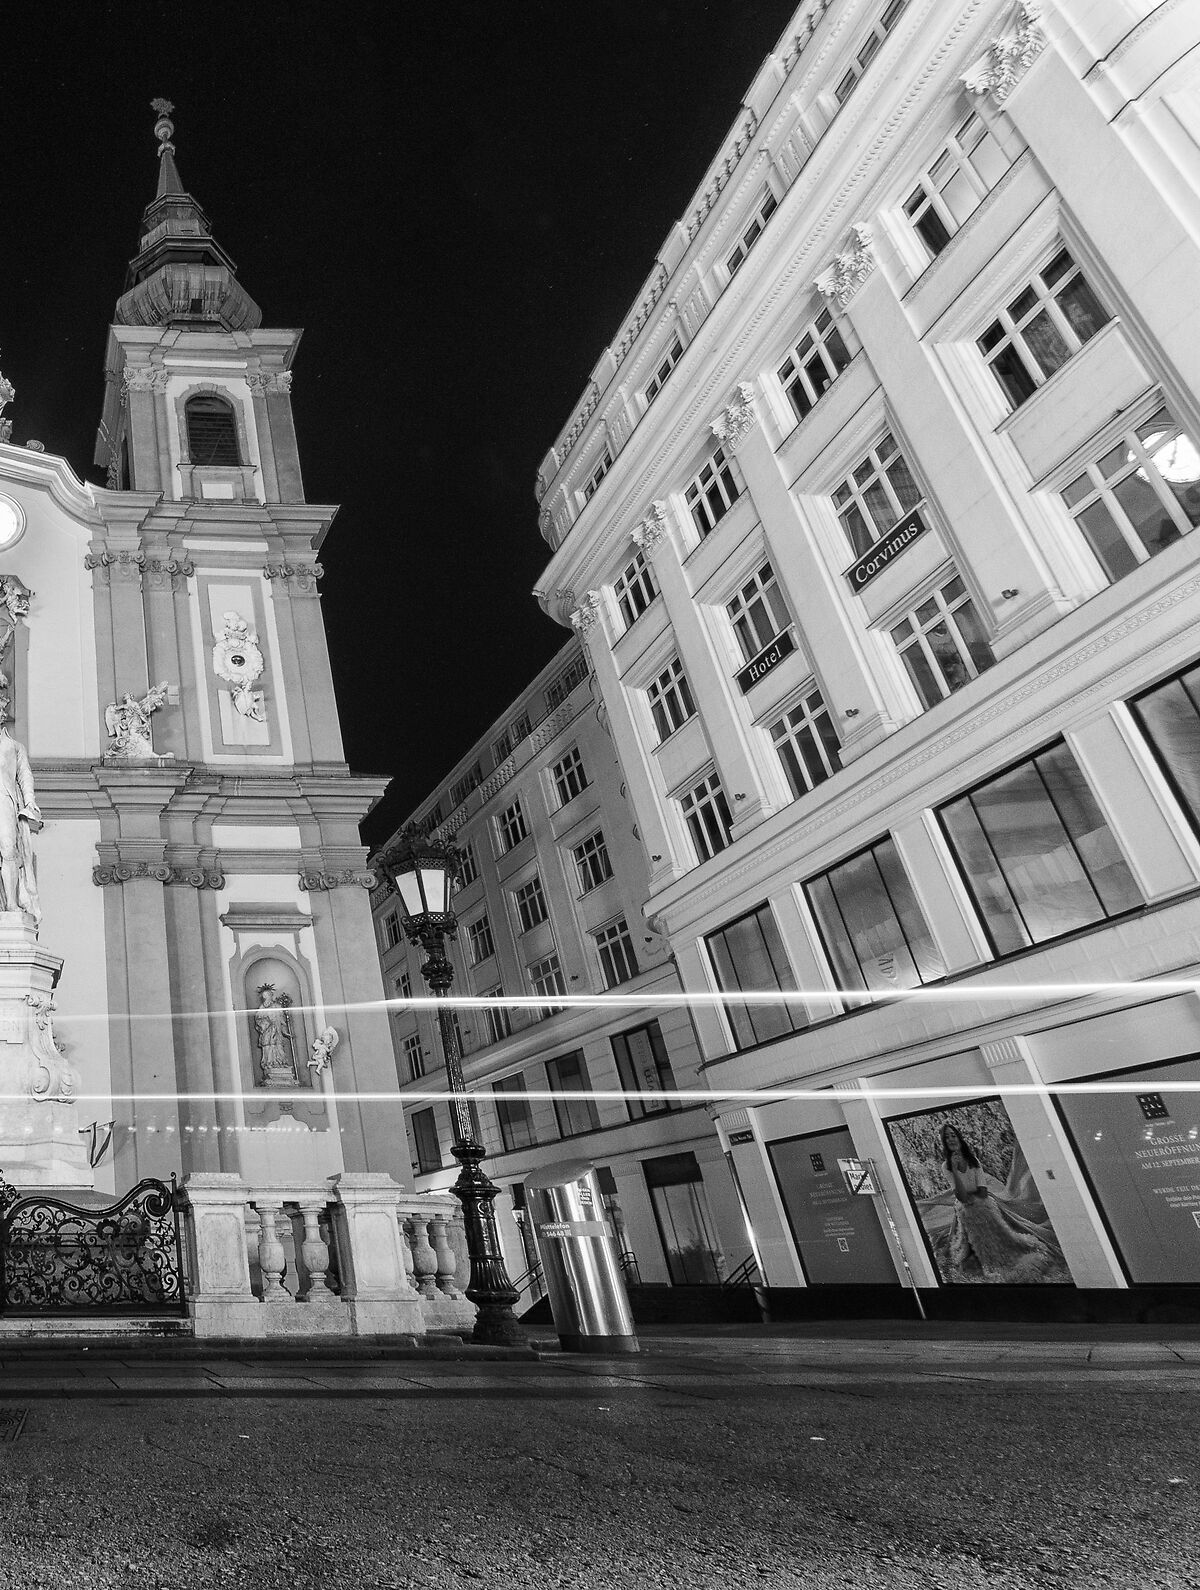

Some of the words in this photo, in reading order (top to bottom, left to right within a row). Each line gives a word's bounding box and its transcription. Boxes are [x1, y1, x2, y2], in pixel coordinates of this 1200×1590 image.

[855, 523, 918, 583] Corvinus
[749, 644, 781, 682] Hotel
[1150, 1134, 1186, 1146] GROSSE
